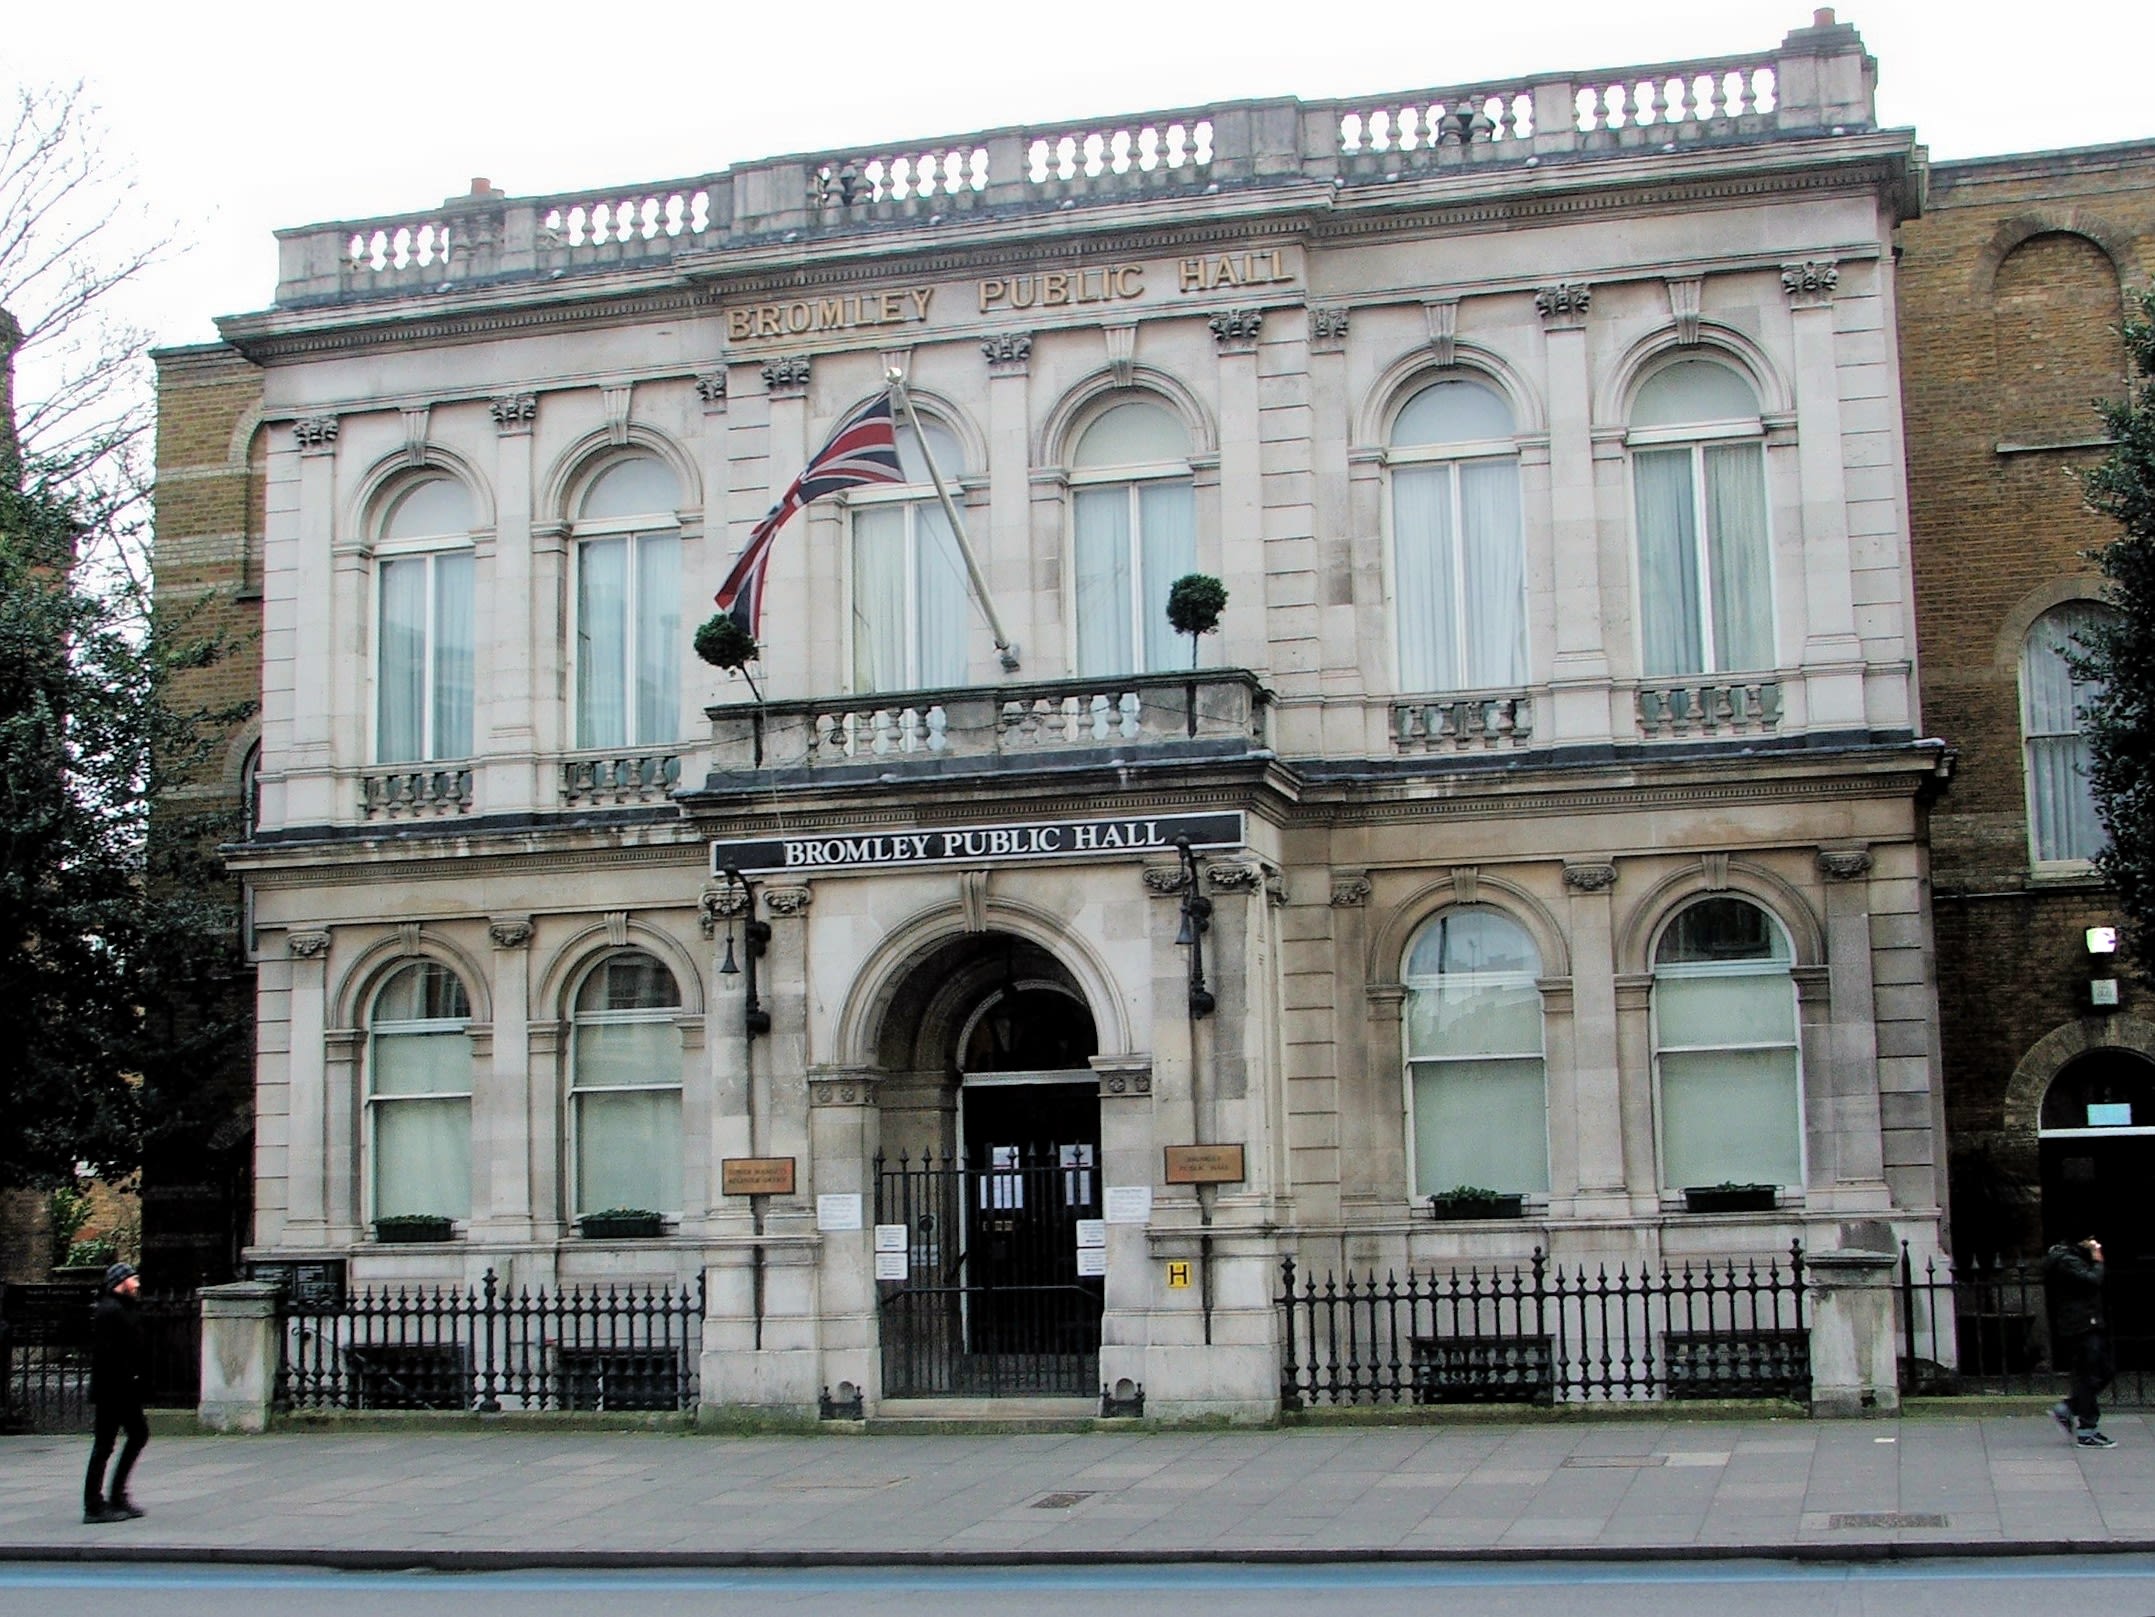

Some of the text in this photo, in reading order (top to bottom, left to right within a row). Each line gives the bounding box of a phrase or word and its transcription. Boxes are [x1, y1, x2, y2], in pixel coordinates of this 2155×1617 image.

[729, 250, 1294, 341] BROMLEY PUBLIC HALL
[785, 822, 1166, 866] BROMLEY PUBLIC HALL
[1170, 1264, 1187, 1285] H
